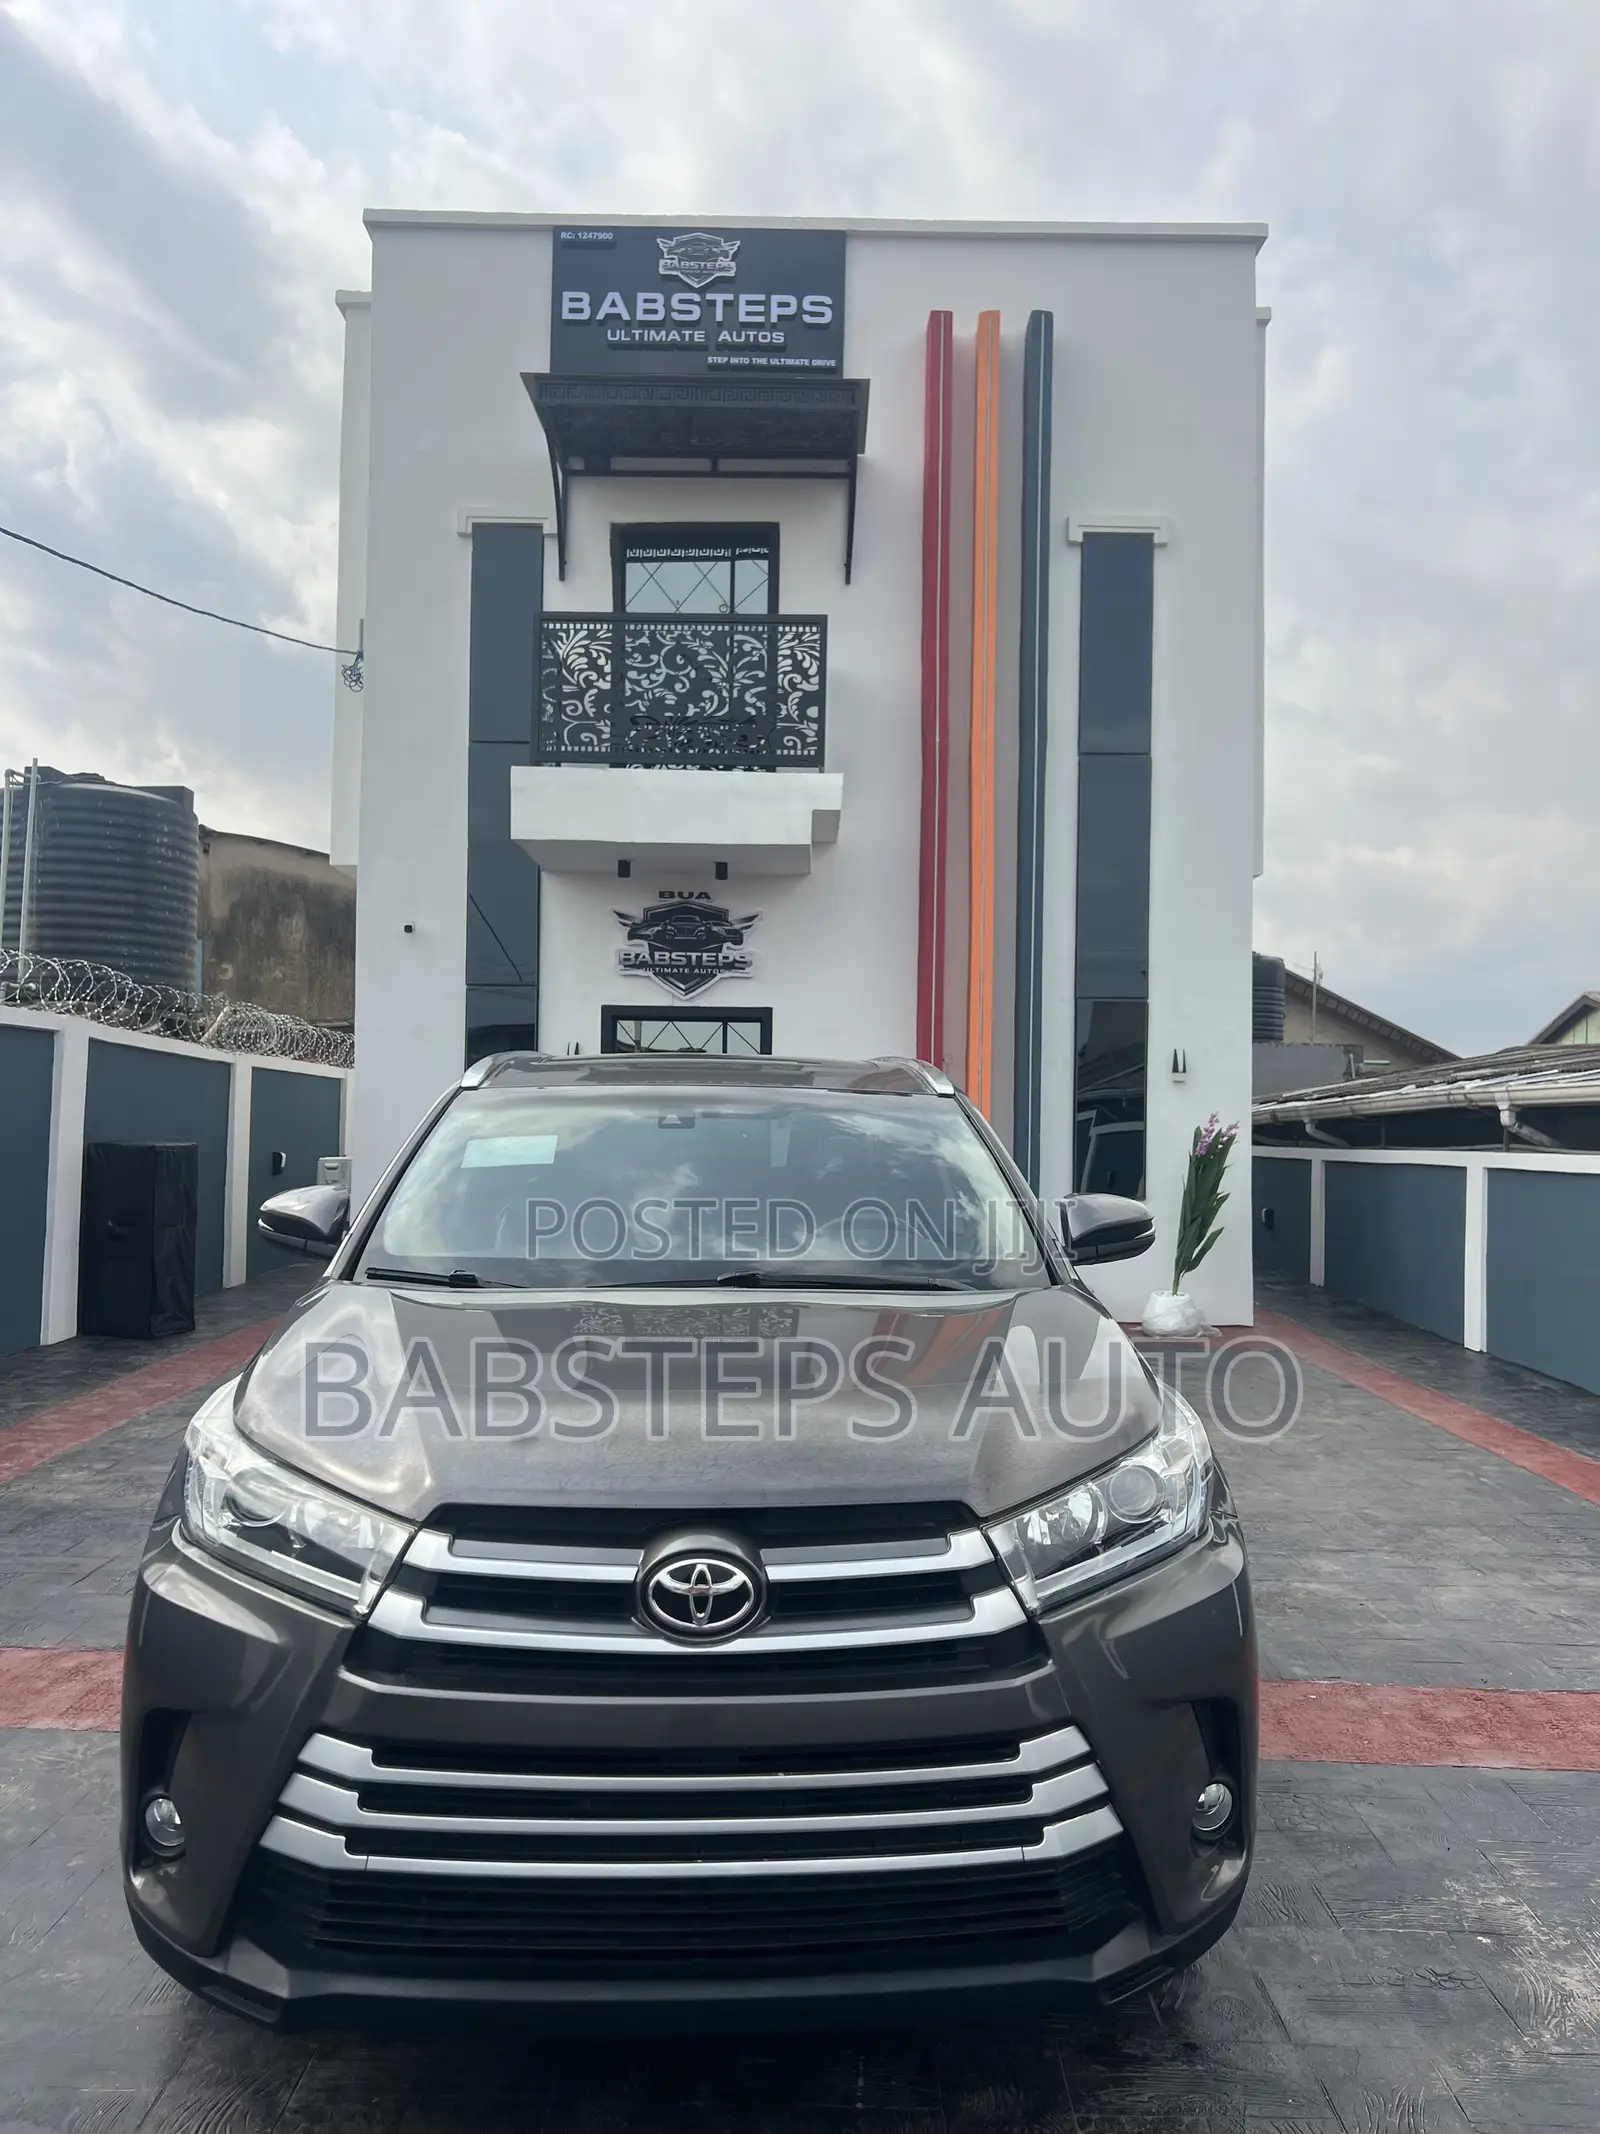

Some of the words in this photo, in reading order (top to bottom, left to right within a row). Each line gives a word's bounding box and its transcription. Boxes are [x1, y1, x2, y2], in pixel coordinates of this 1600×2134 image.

[561, 291, 833, 324] BABSTEPS
[607, 329, 706, 342] ULTIMATE
[718, 330, 785, 343] AUTOS
[707, 356, 728, 364] STEP
[751, 357, 768, 365] THE
[769, 358, 810, 366] ULTIMATE
[811, 359, 836, 367] DRIVE
[658, 890, 712, 900] BUA
[619, 951, 753, 967] BABSTEPS
